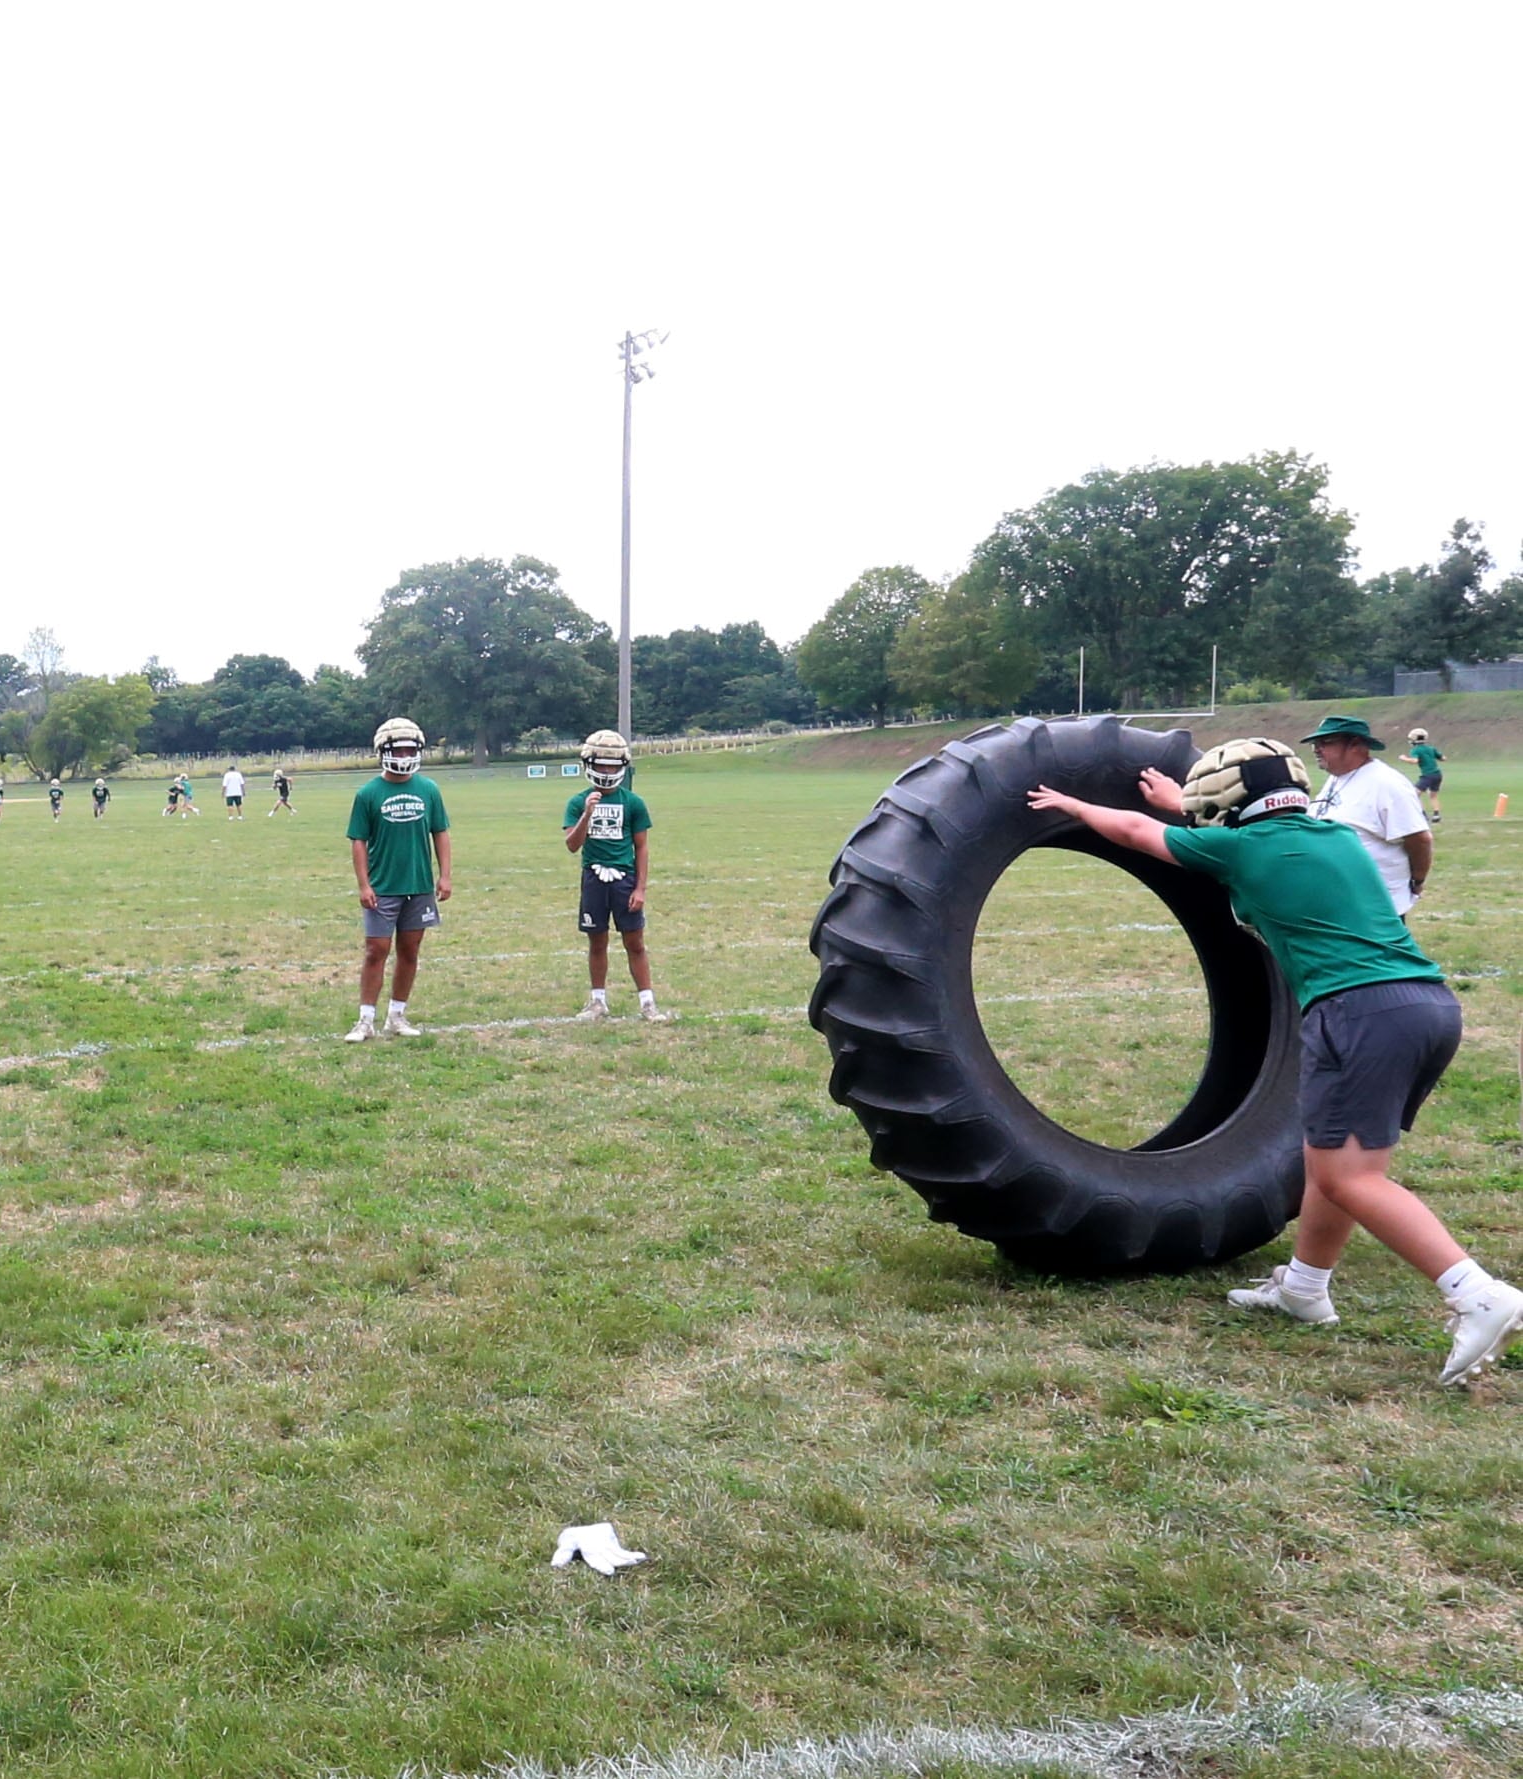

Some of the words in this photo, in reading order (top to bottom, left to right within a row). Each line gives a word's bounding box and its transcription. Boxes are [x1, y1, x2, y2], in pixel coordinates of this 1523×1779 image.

[381, 803, 404, 814] SAINT
[405, 802, 425, 811] BEDE
[592, 808, 620, 818] BUILT
